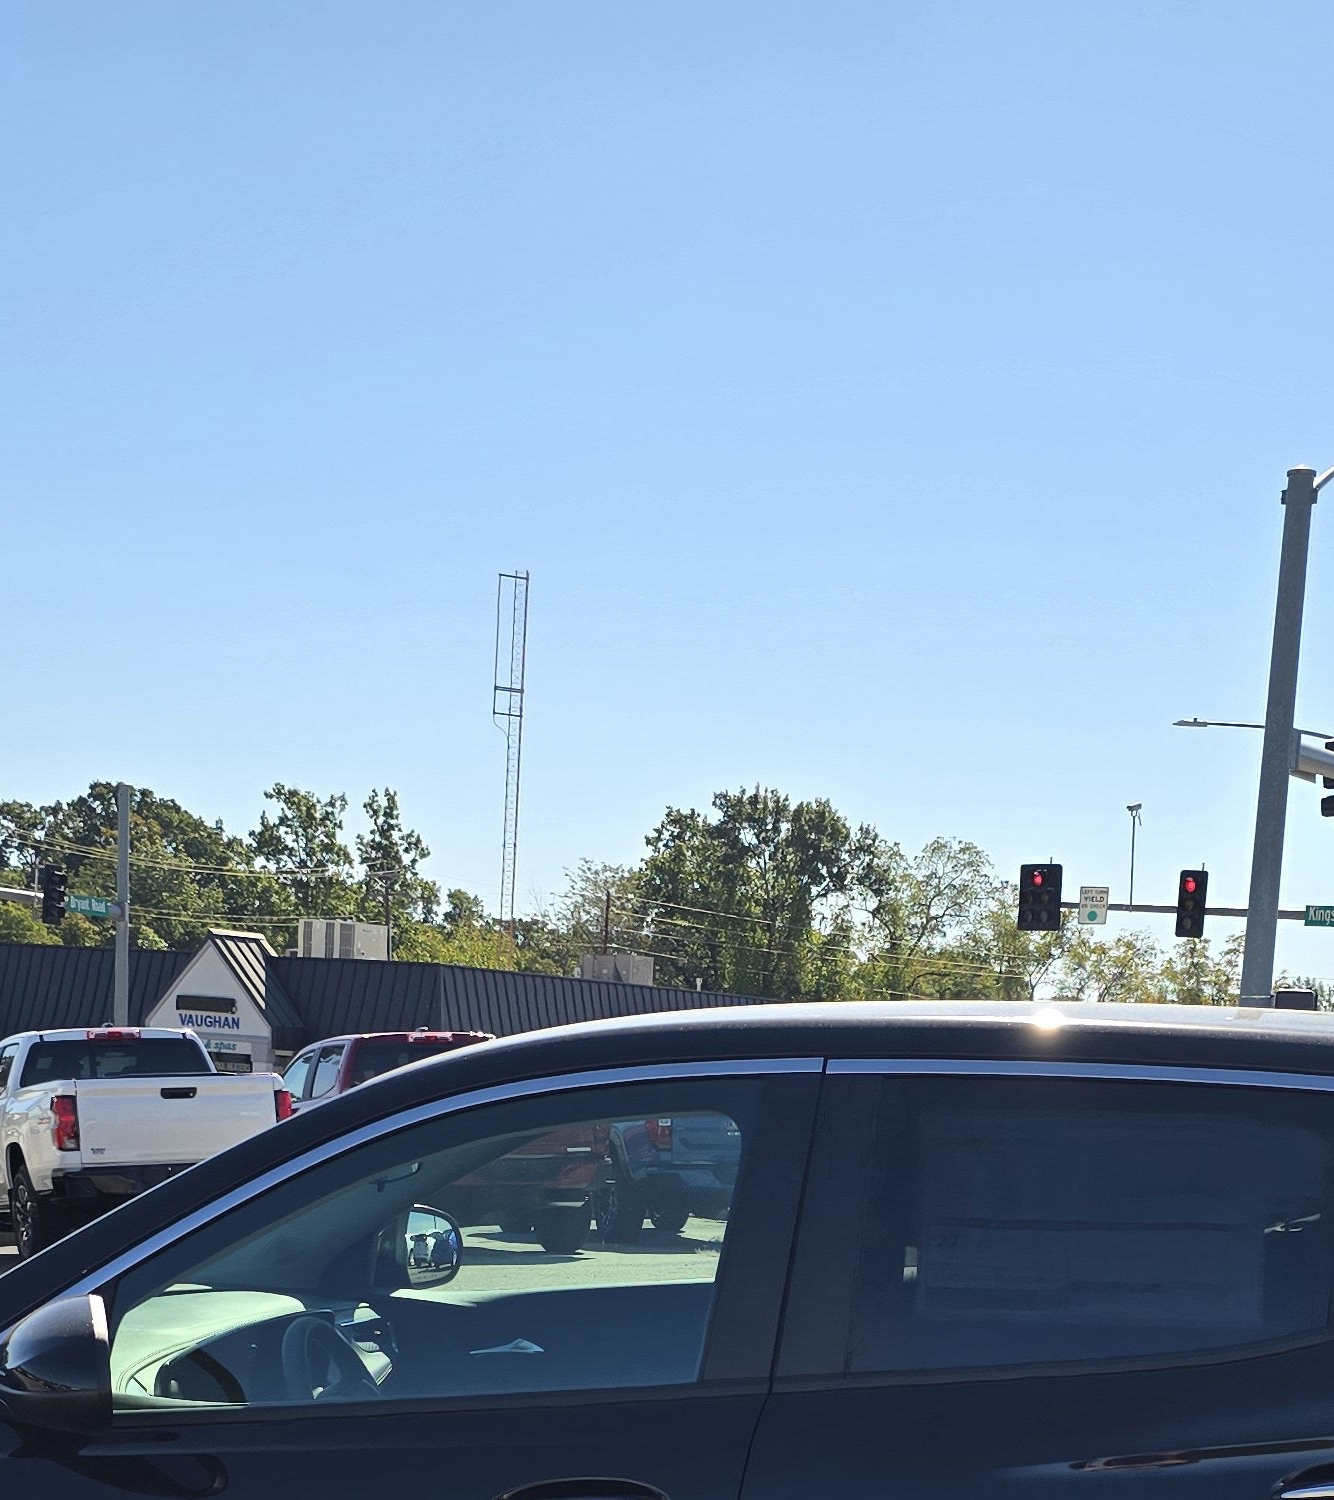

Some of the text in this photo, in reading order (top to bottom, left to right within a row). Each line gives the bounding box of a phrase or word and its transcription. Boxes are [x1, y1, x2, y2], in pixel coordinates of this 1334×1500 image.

[70, 895, 107, 913] Bryant Road
[178, 1012, 240, 1030] VAUGHAN
[214, 1041, 237, 1053] spas
